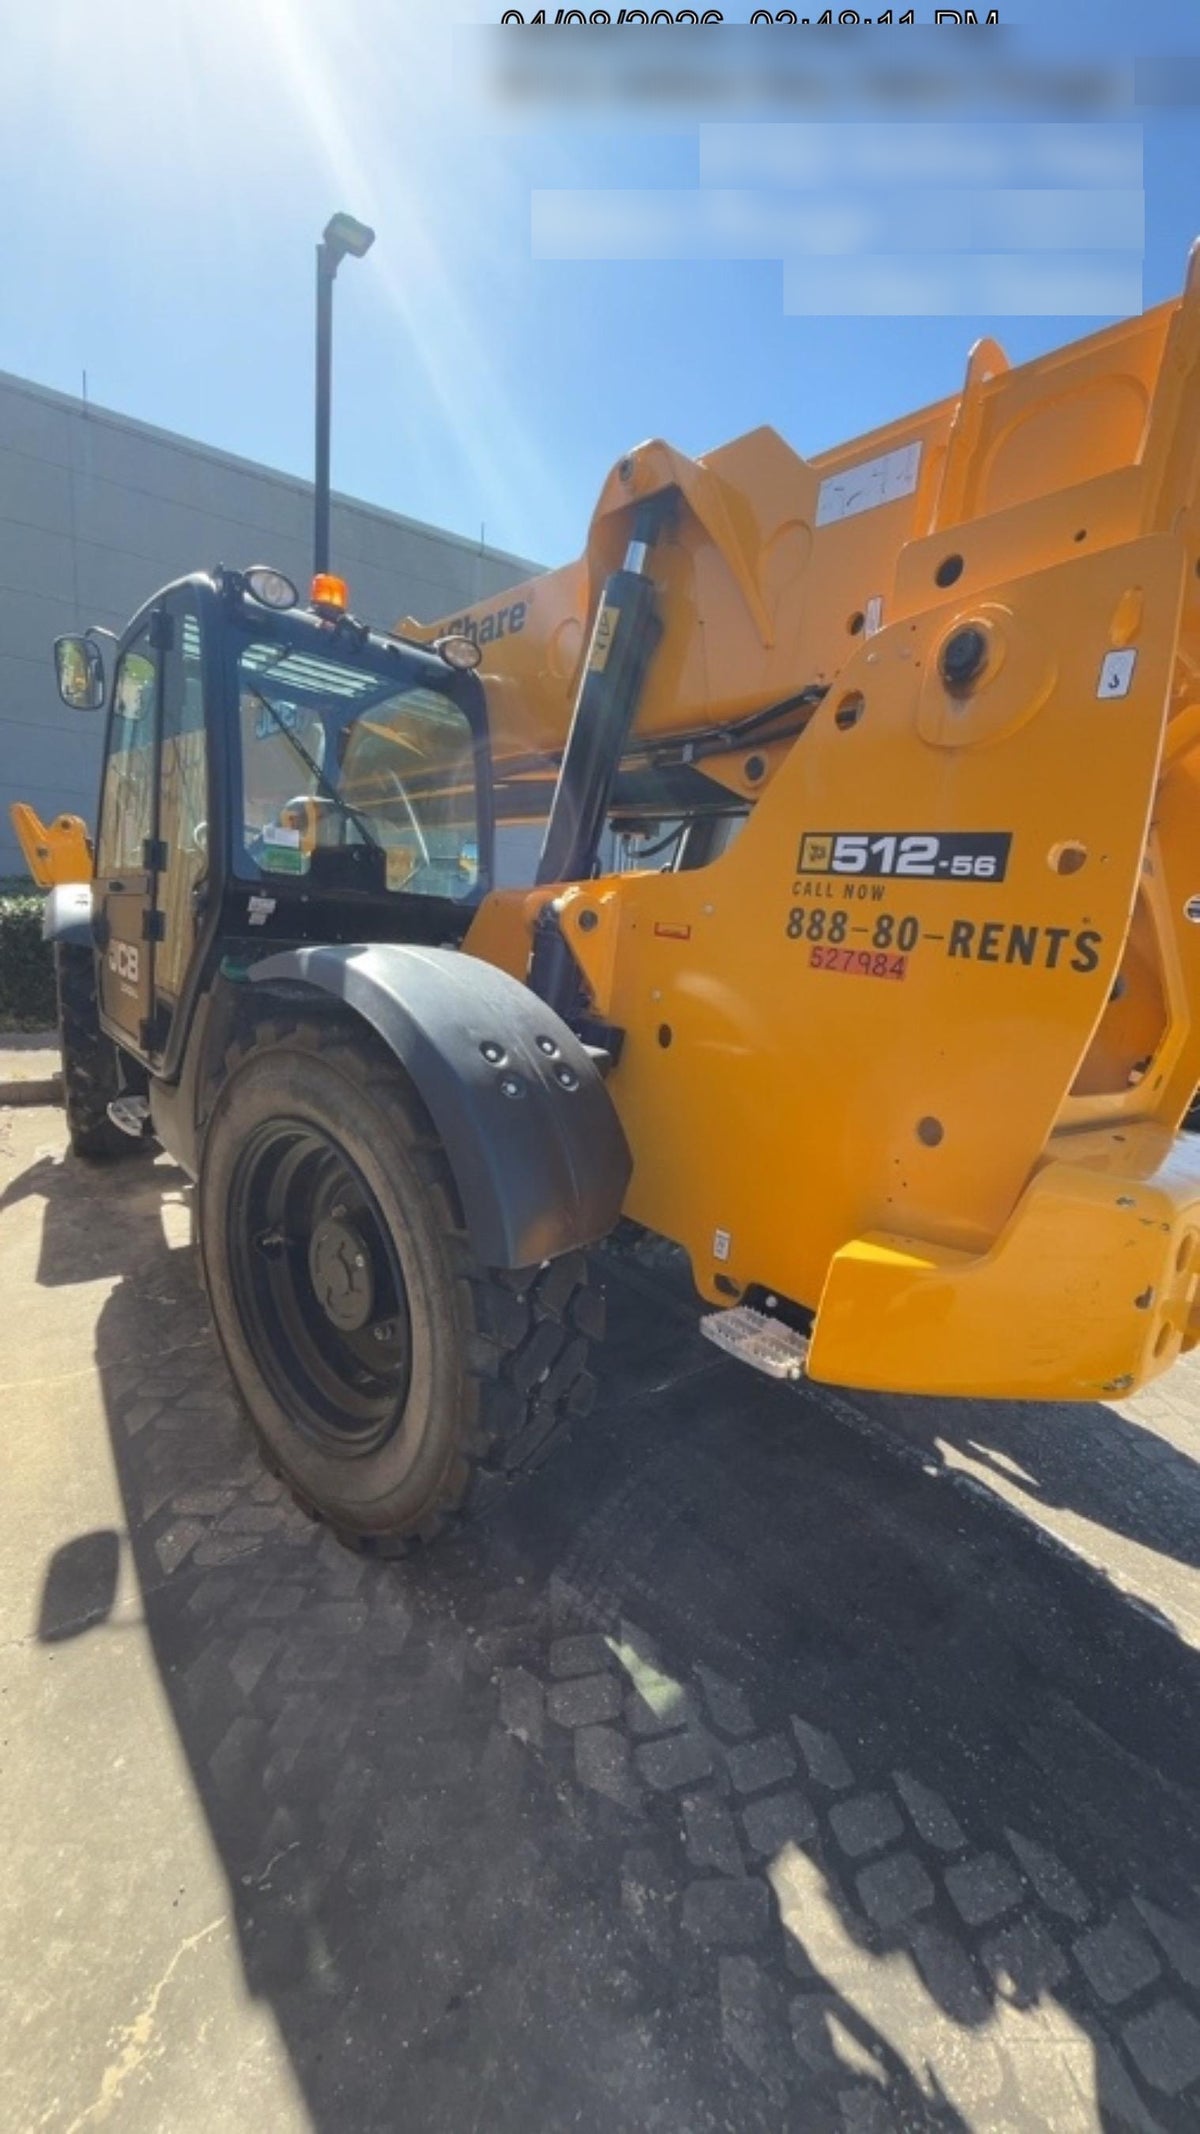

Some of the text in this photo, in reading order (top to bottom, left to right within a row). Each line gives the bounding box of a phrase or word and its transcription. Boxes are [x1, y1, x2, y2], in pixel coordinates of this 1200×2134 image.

[831, 836, 997, 876] 512-56
[792, 881, 885, 901] CALL NOW
[786, 907, 1102, 973] 888-80-RENTS
[810, 946, 905, 980] 527984
